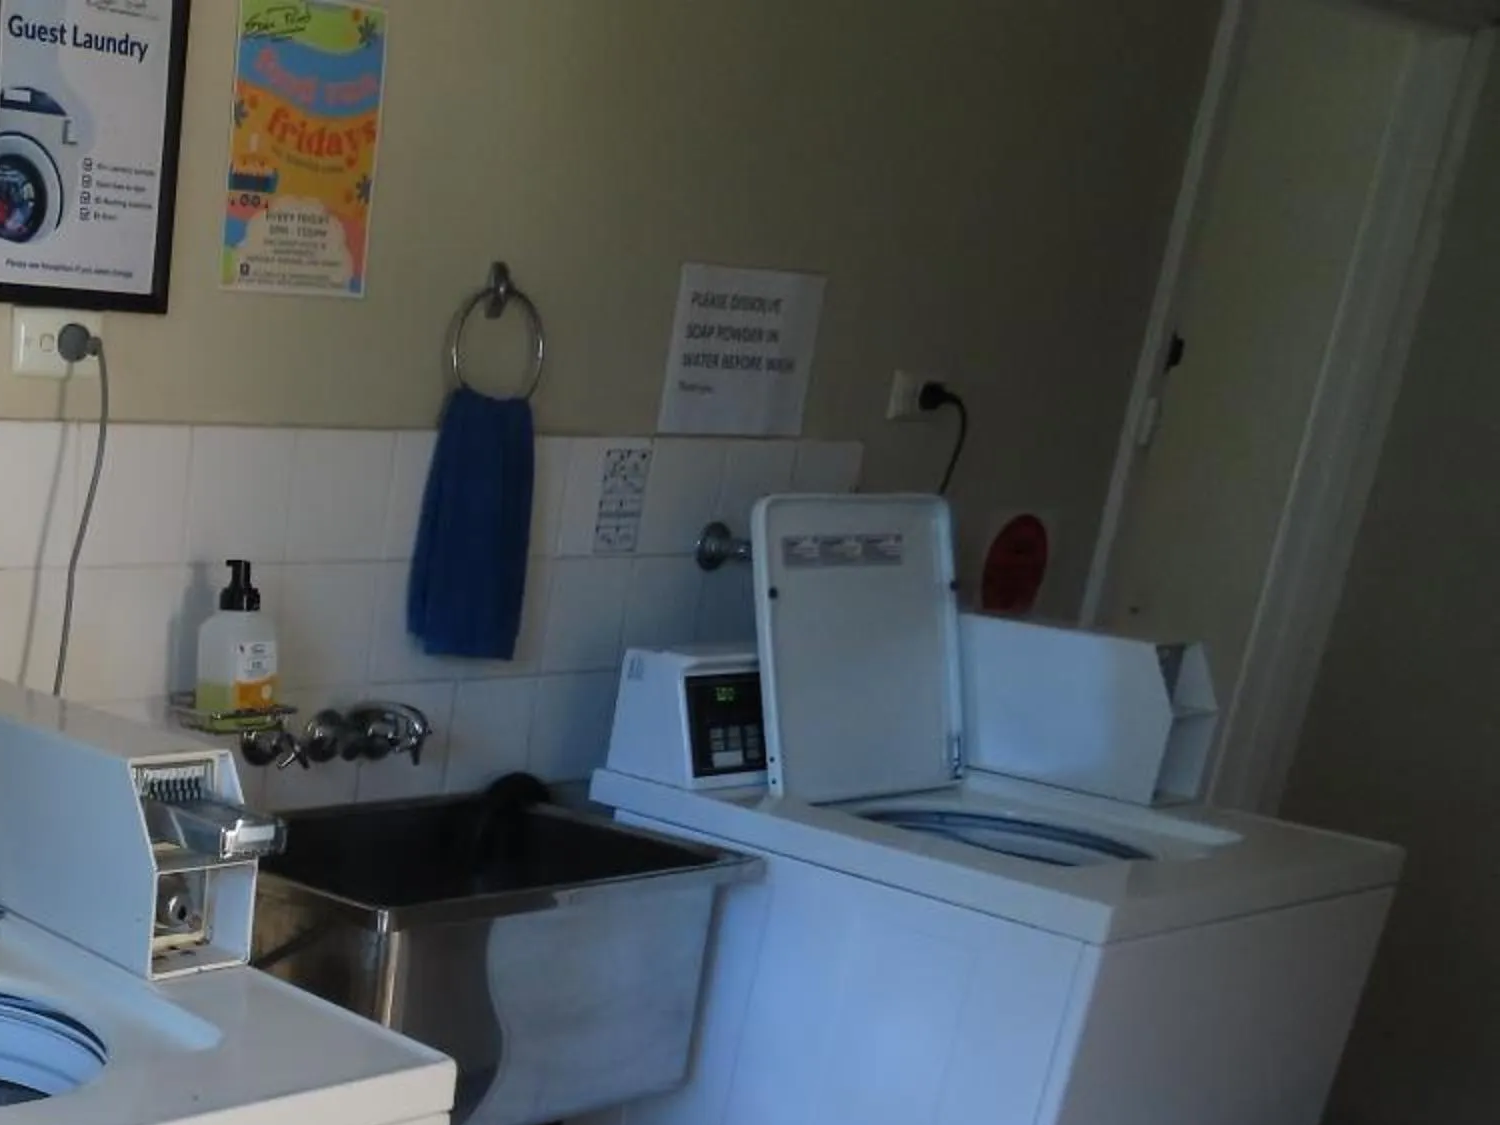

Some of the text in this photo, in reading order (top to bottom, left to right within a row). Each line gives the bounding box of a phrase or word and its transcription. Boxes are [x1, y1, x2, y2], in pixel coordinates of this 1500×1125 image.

[7, 15, 150, 63] Guest Laundry
[684, 322, 715, 340] SOAP
[681, 351, 720, 370] WATER
[721, 353, 763, 372] BEFORE
